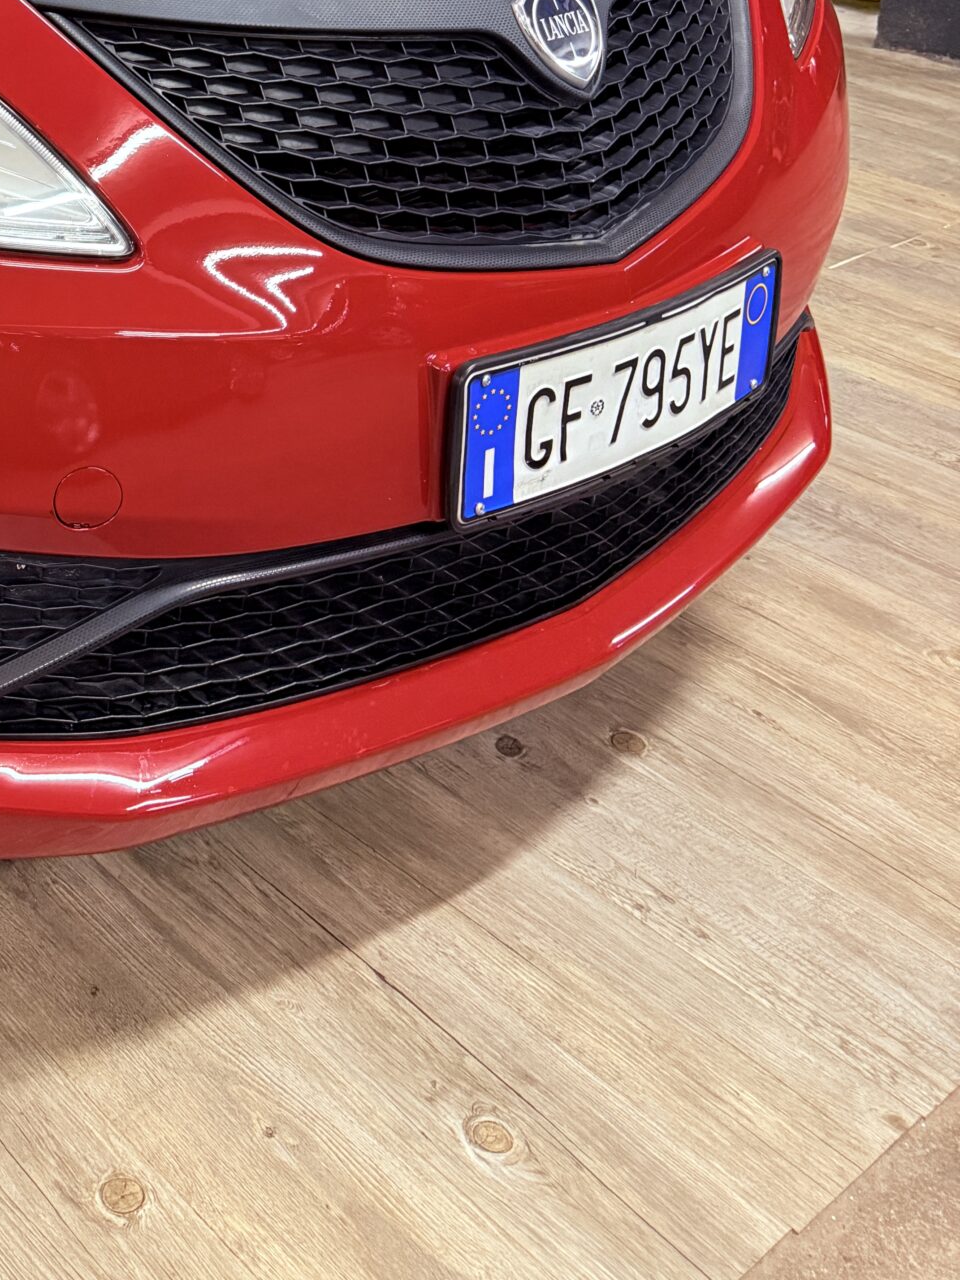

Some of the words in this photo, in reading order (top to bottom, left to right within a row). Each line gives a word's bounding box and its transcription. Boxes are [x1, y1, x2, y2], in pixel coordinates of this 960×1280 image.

[540, 9, 590, 41] LANCIA
[524, 373, 593, 470] GF
[609, 308, 742, 446] 795YE
[483, 447, 496, 499] I
